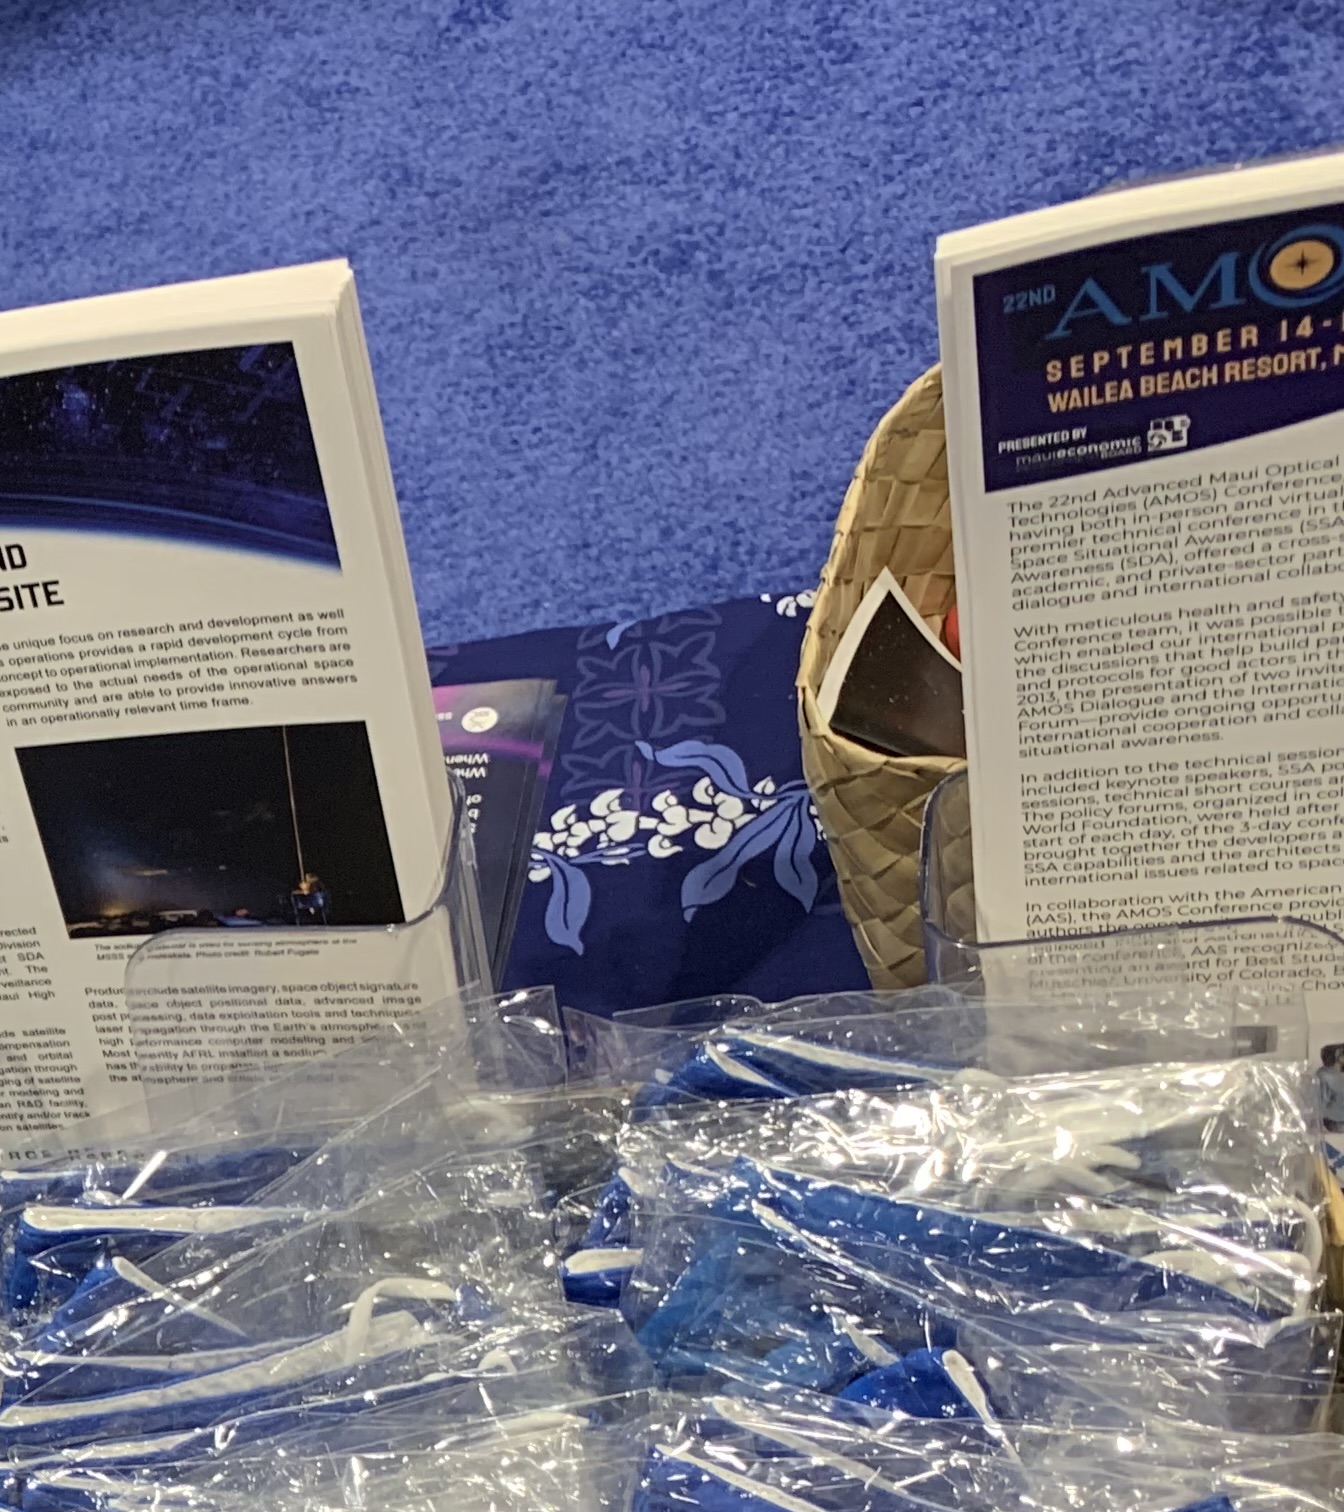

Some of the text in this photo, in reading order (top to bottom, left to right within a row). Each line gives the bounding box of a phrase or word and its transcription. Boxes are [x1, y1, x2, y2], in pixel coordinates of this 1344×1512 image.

[1001, 284, 1057, 313] 22ND
[1045, 324, 1259, 382] SEPTEMBER
[1046, 346, 1327, 413] WAILEA BEACH RESORT,
[997, 426, 1088, 453] PRESENTED BY
[1006, 454, 1339, 514] The 22nd Advanced Maui Optical
[12, 637, 56, 650] unique
[58, 633, 94, 645] focus
[96, 630, 114, 641] on
[116, 622, 175, 638] research
[177, 619, 204, 632] and
[206, 611, 294, 629] development
[296, 612, 314, 622] as
[316, 607, 344, 620] well
[1017, 731, 1224, 758] situational awareness.
